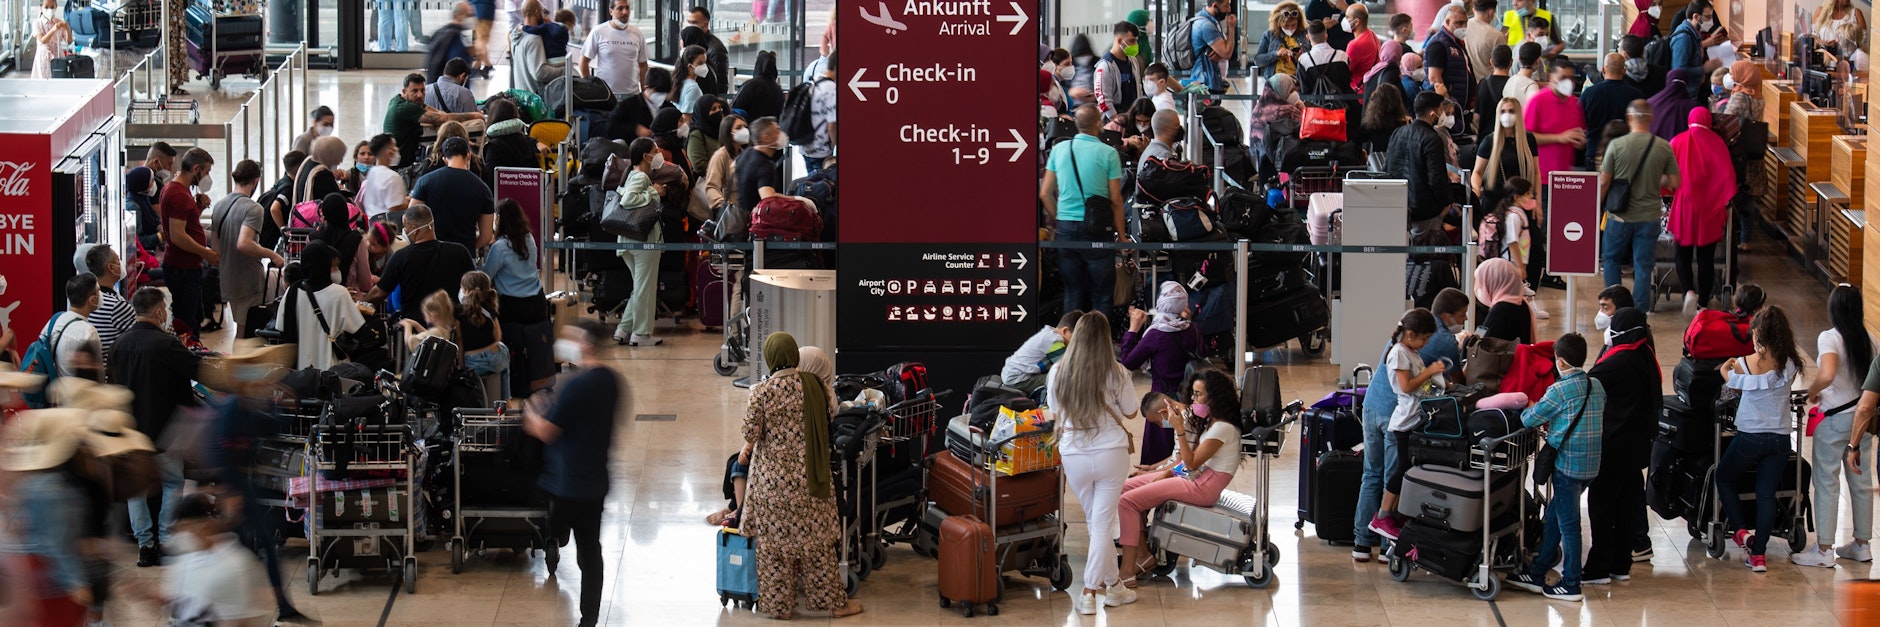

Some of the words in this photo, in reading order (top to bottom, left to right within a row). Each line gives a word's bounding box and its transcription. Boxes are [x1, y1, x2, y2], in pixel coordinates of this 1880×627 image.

[903, 0, 991, 16] Ankunft
[938, 20, 991, 36] Arrival
[885, 63, 976, 82] Check-in
[885, 87, 899, 105] 0
[899, 124, 990, 143] Check-in
[922, 253, 947, 261] Airline
[948, 253, 975, 261] Service
[858, 279, 885, 288] Airport
[870, 287, 886, 296] City
